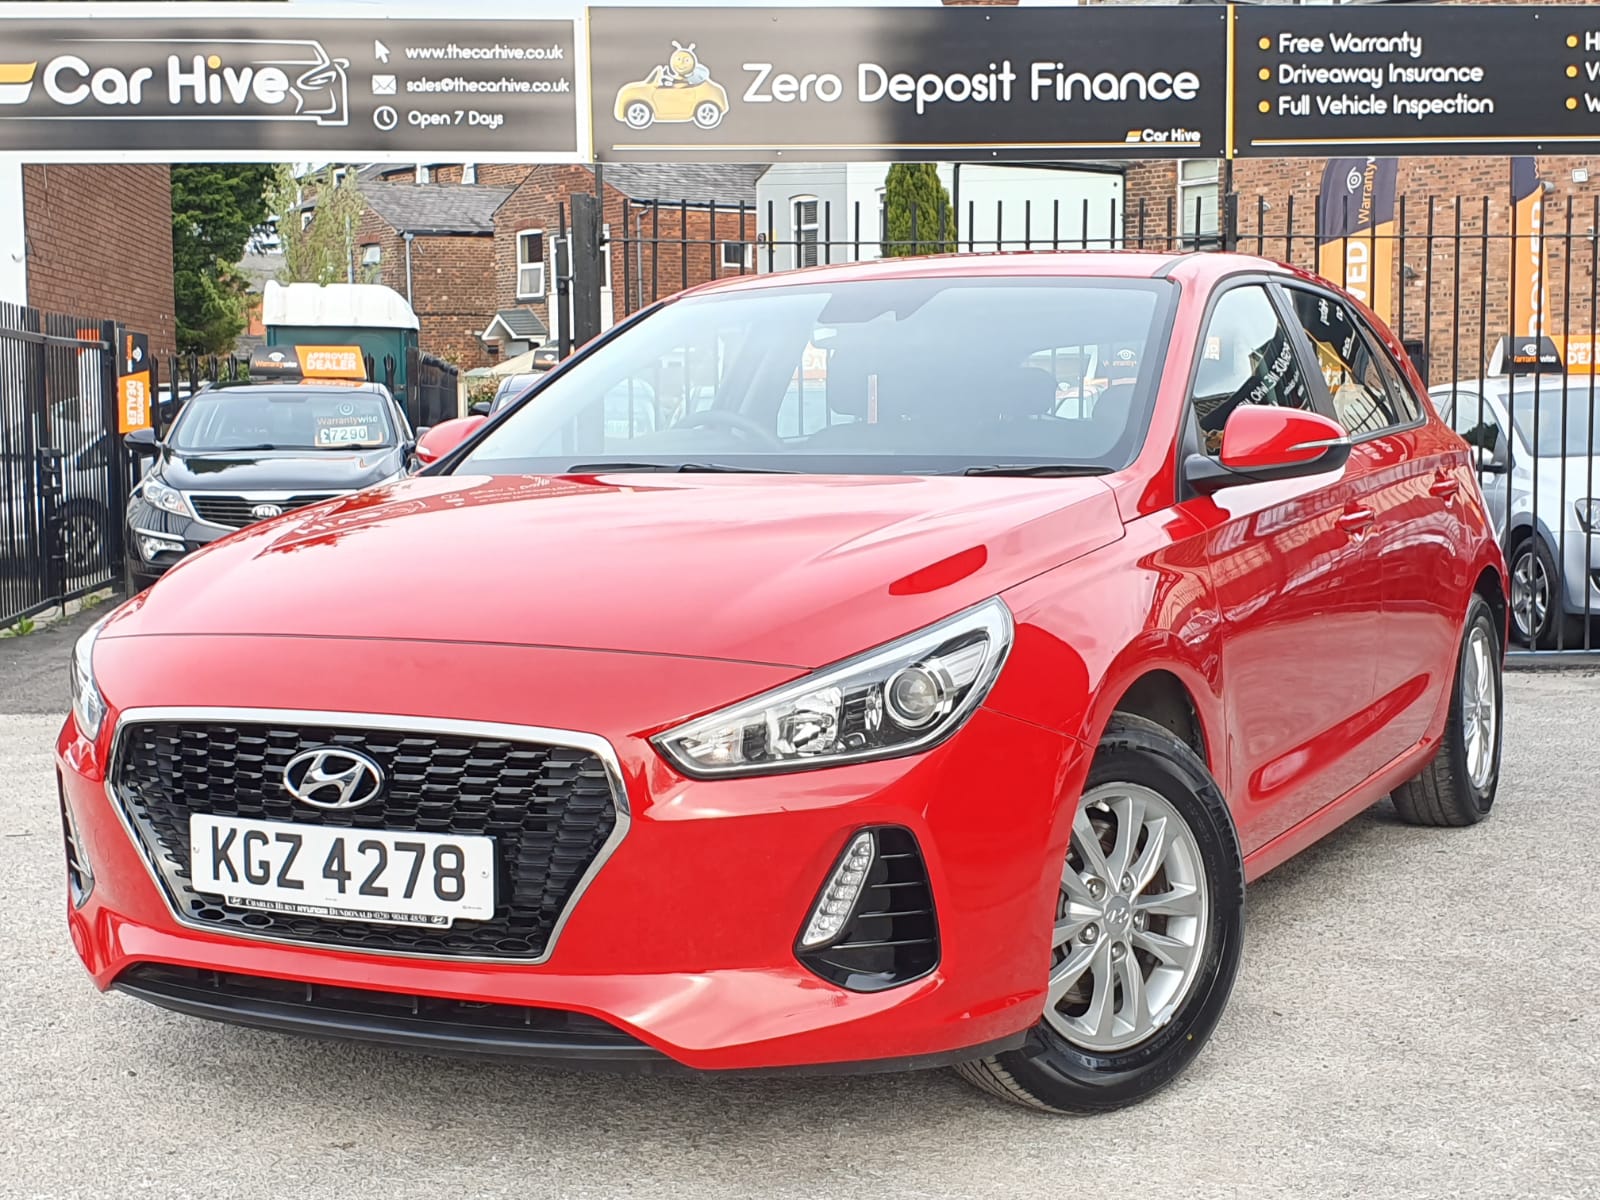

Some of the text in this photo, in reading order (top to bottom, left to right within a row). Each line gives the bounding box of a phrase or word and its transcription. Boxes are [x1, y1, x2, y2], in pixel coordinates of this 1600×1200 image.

[405, 44, 564, 60] www.thecarhive.co.uk
[1279, 31, 1422, 58] Free Warranty
[43, 54, 289, 105] Car Hive
[406, 77, 570, 95] sales@thecarhive.co.uk
[1278, 62, 1484, 89] Driveaway Insurance
[742, 61, 1200, 114] Zero Deposit Finance
[1278, 92, 1494, 120] Full Vehicle Inspection
[408, 110, 504, 129] Open 7 Days
[1142, 128, 1201, 142] Car Hive
[306, 359, 356, 371] DEALER
[307, 352, 356, 360] APPROVED
[126, 380, 137, 426] DEALER
[316, 415, 379, 426] Warrantywise
[211, 825, 466, 903] KGZ 4278
